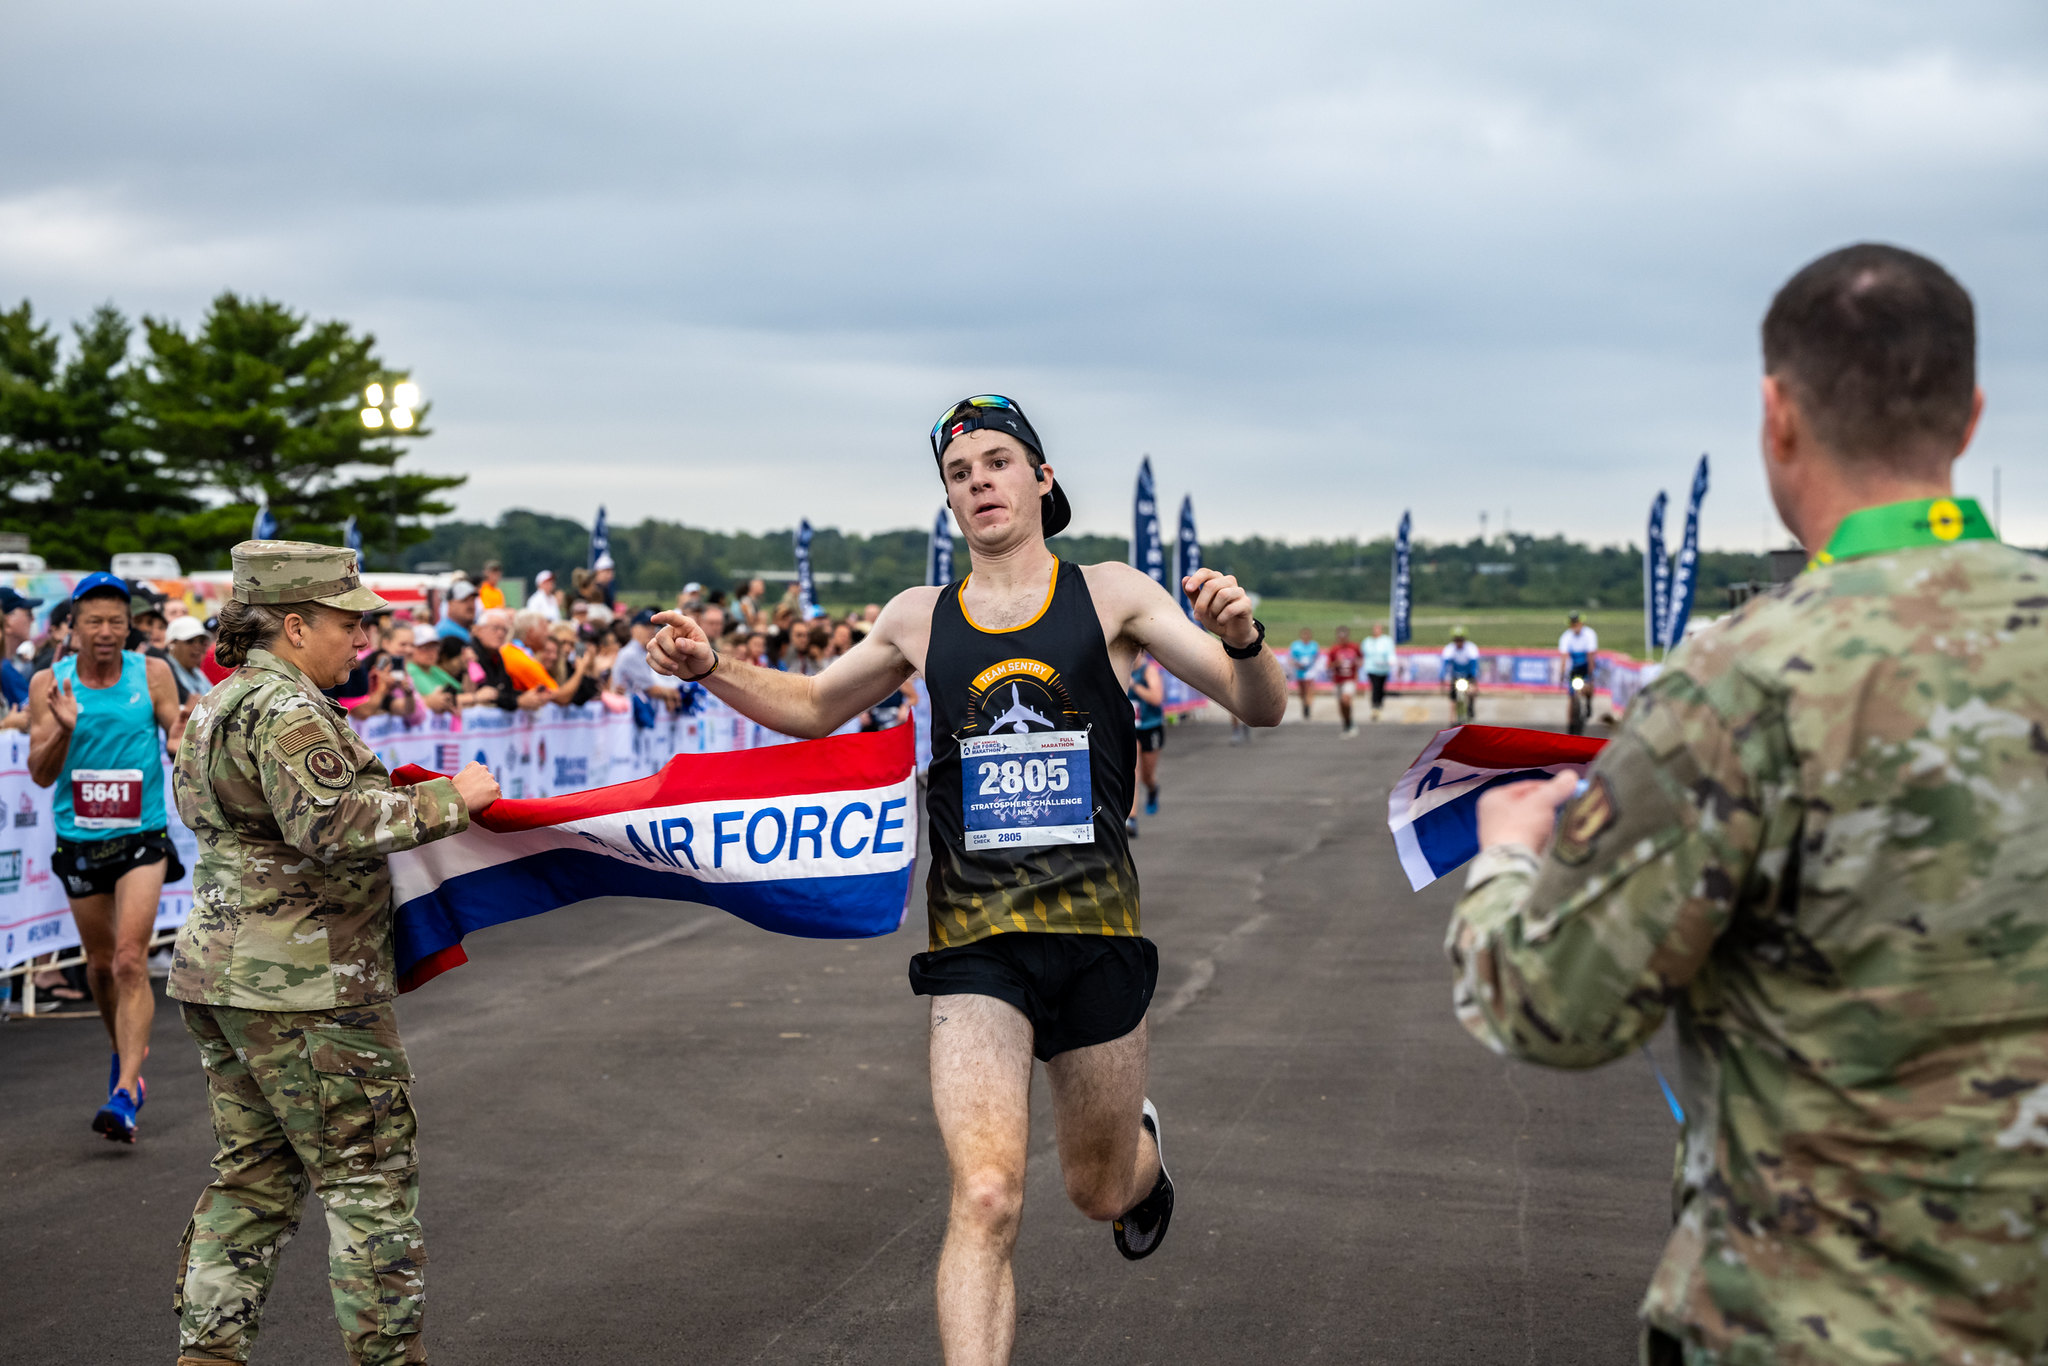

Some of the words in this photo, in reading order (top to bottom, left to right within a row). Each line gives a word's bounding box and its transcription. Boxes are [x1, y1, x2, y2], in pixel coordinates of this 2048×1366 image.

[979, 665, 1007, 684] TEAM
[1007, 661, 1047, 675] SENTRY
[978, 758, 1069, 795] 2805
[81, 783, 130, 802] 5641
[970, 800, 1032, 811] STRATOSPHERE
[1033, 797, 1083, 807] CHALLENGE
[625, 816, 700, 870] AIR
[713, 797, 906, 869] FORCE
[998, 832, 1022, 842] 2805
